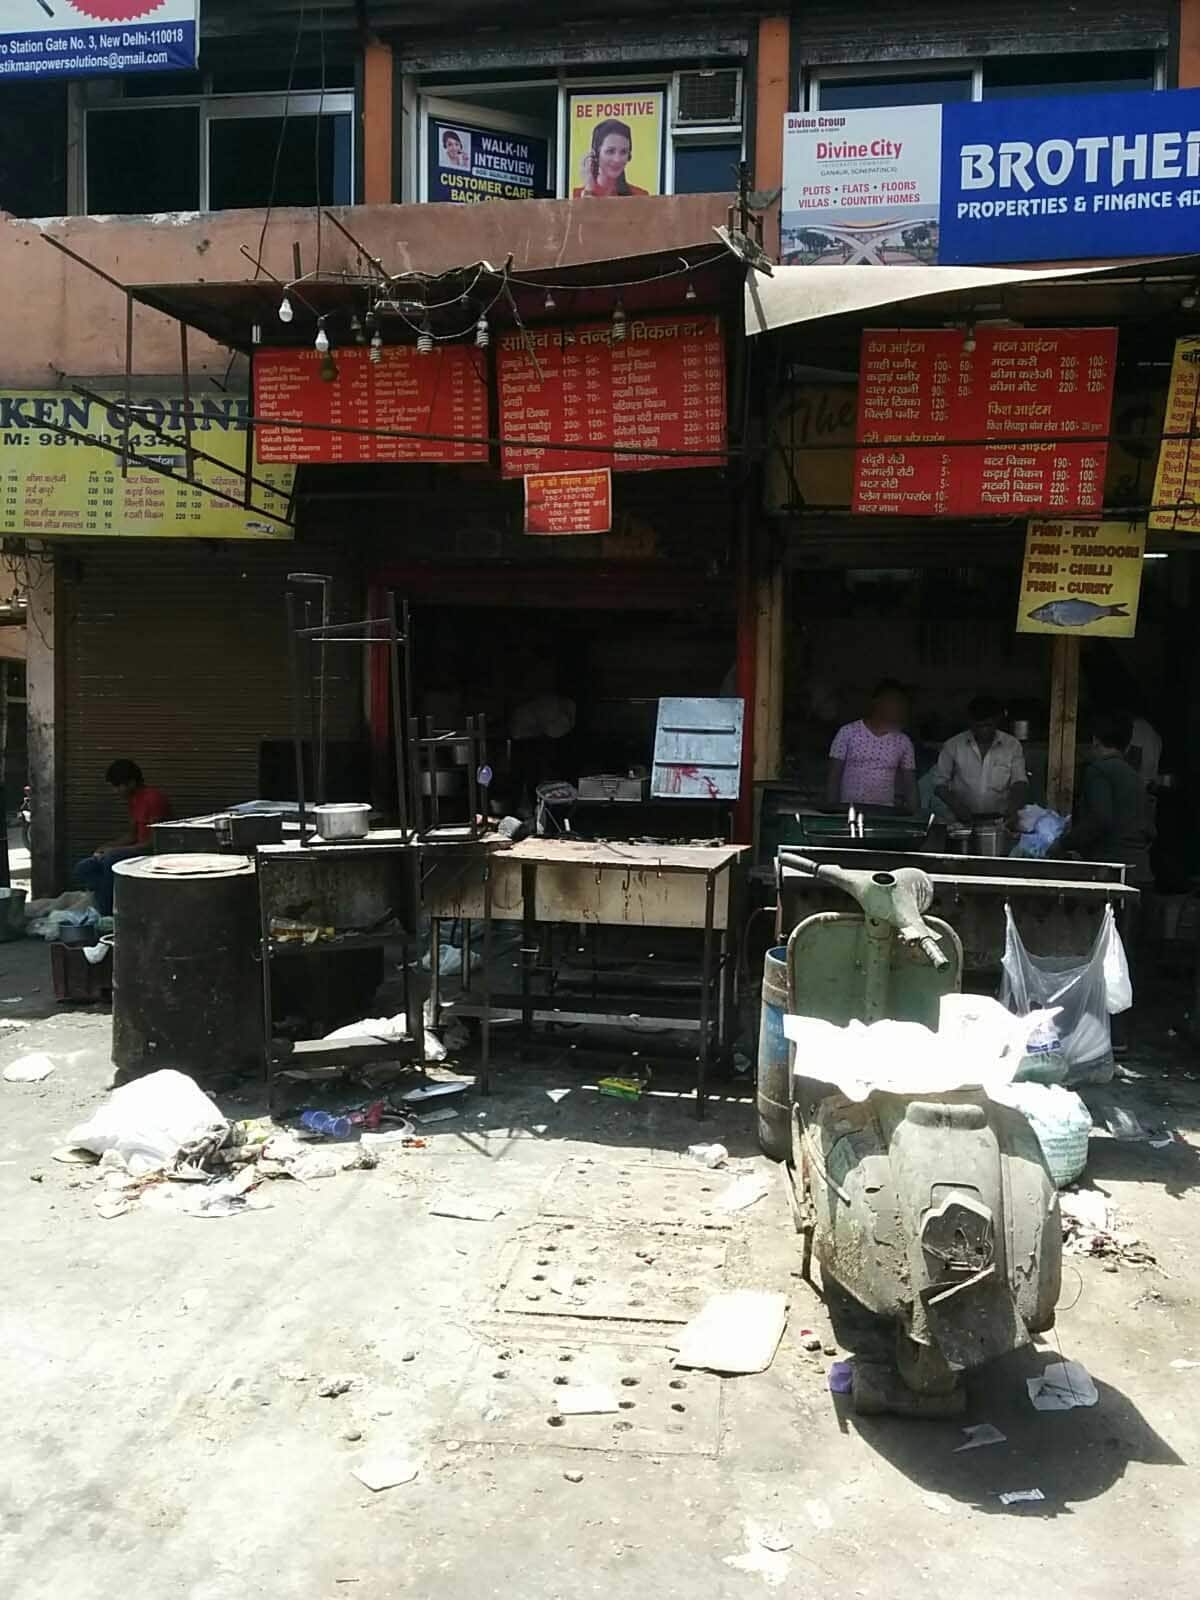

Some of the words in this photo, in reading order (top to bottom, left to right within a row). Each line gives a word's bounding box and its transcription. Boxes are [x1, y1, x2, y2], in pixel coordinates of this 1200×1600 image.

[10, 40, 43, 54] Station
[45, 37, 68, 51] Gate
[70, 36, 86, 50] No.
[89, 34, 97, 50] 3,
[99, 33, 120, 48] New
[122, 28, 183, 47] Delhi-110018
[576, 104, 593, 118] BE
[596, 101, 654, 117] POSITIVE
[788, 118, 816, 128] Divine
[818, 116, 846, 127] Group
[481, 136, 529, 159] WALK-IN
[816, 141, 868, 160] Divine
[870, 138, 903, 159] City
[474, 152, 536, 176] INTERVIEW
[440, 173, 502, 195] CUSTOMER
[504, 185, 535, 200] CARE
[802, 185, 831, 196] PLOTS
[842, 183, 870, 194] FLATS
[881, 181, 917, 191] FLOORS
[451, 188, 481, 202] BACK
[798, 198, 830, 209] VILLAS
[840, 195, 883, 207] COUNTRY
[886, 193, 921, 204] HOMES
[957, 197, 1068, 219] PROPERTIES
[1074, 196, 1087, 212] &
[1094, 191, 1172, 213] FINANCE
[0, 398, 91, 429] KEN
[4, 433, 30, 446] M:
[1006, 454, 1036, 467] चिकन
[1013, 467, 1044, 479] चिकन
[1012, 480, 1043, 491] चिकन
[1012, 492, 1042, 504] चिकन
[1031, 524, 1062, 537] FISH
[1073, 526, 1099, 538] FRY
[1030, 543, 1060, 556] FISH
[1071, 544, 1140, 559] TANDOORI
[1028, 561, 1059, 574] FISH
[1069, 563, 1113, 577] CHILLI
[1026, 580, 1057, 593] FISH
[1067, 581, 1114, 595] CURRY
